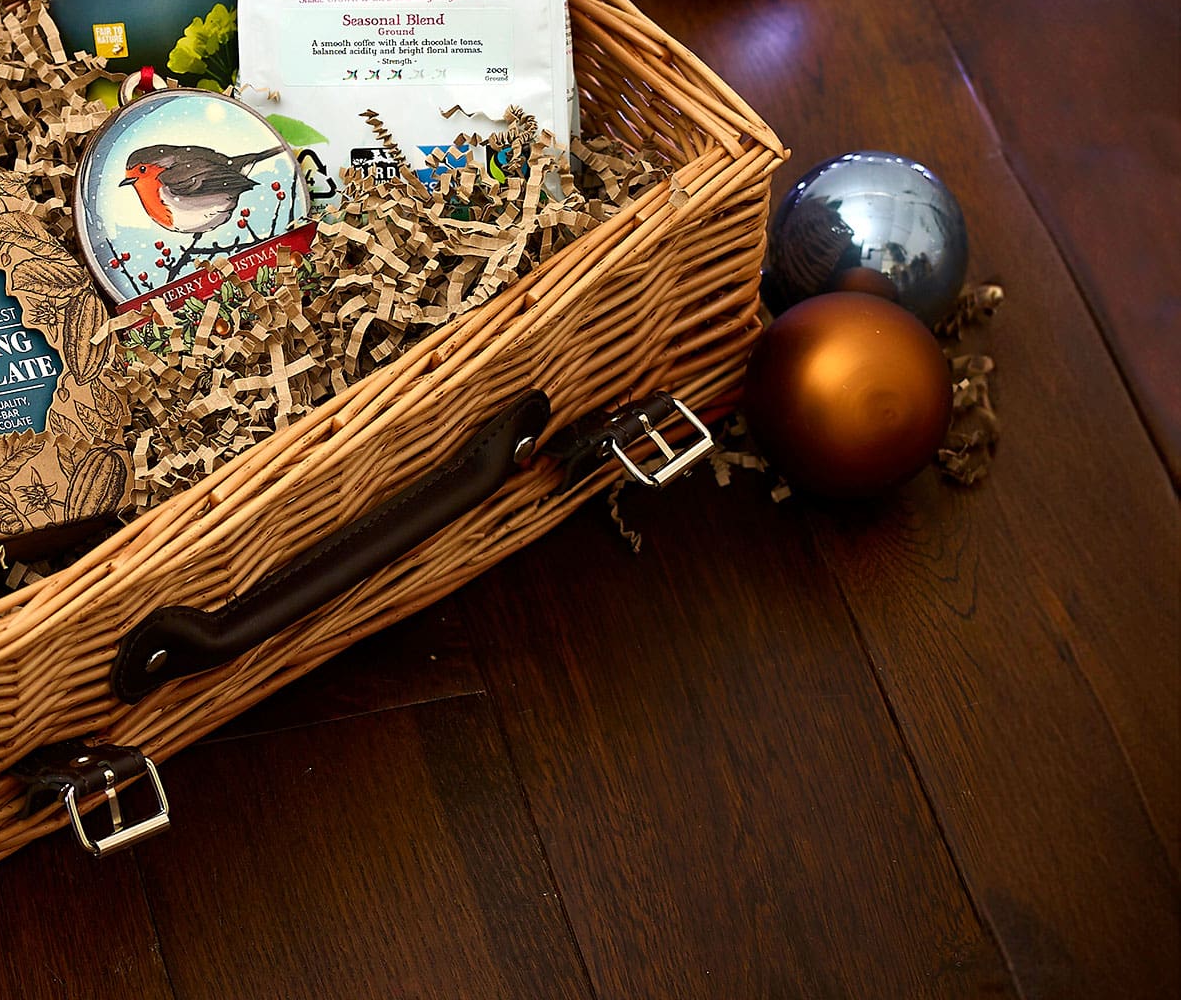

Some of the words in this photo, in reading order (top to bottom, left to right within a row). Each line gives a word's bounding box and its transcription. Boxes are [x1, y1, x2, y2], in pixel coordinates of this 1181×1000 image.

[341, 13, 402, 27] Seasonal
[405, 12, 446, 27] Blend
[377, 27, 416, 37] Ground
[311, 39, 319, 48] A
[320, 39, 352, 48] smooth
[353, 38, 376, 48] coffee
[377, 38, 398, 48] with
[399, 38, 419, 47] dark
[420, 37, 458, 47] chocolate
[312, 47, 347, 56] balanced
[349, 47, 377, 57] acidity
[379, 47, 396, 55] and
[398, 46, 425, 57] bright
[426, 46, 448, 55] floral
[381, 57, 413, 67] Strength
[485, 66, 508, 76] 200g
